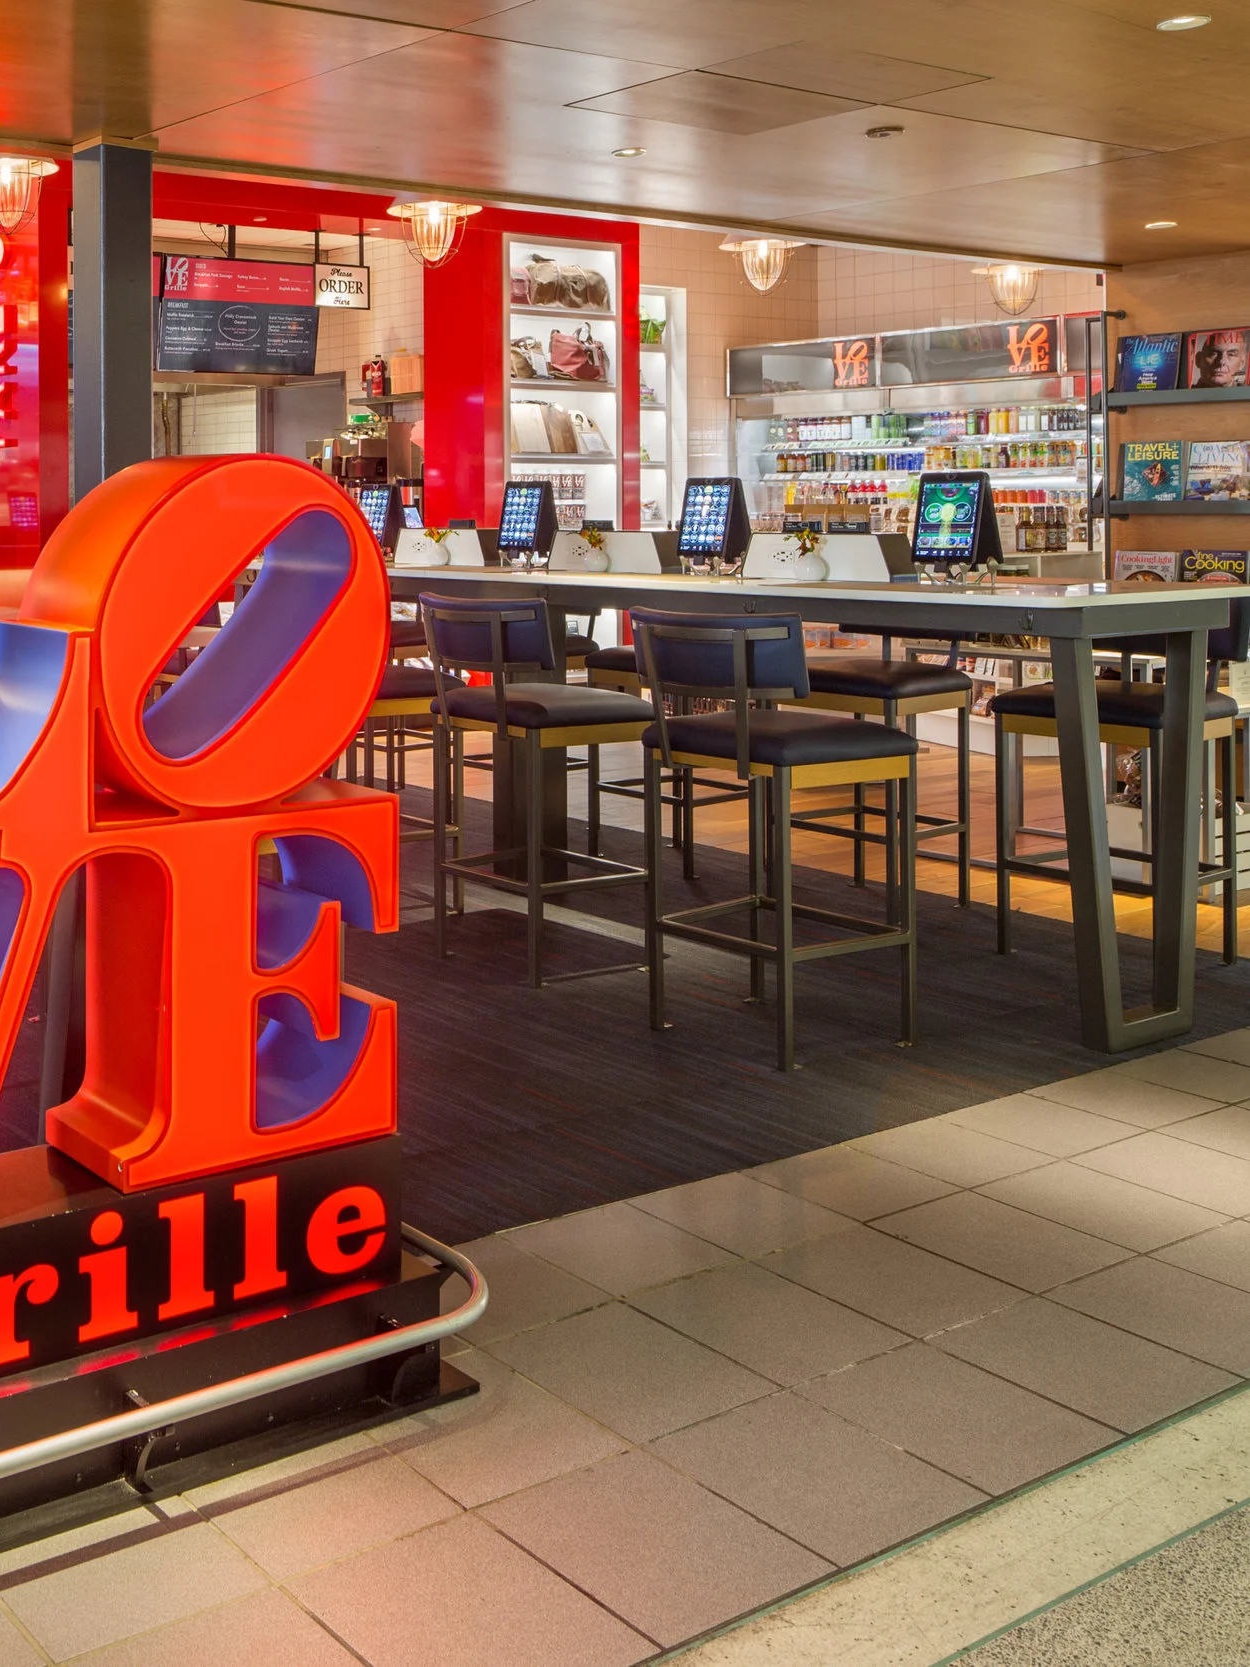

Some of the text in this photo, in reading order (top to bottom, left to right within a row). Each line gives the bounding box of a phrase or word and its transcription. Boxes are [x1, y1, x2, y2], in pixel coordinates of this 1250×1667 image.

[330, 267, 352, 277] Please
[318, 278, 364, 295] ORDER
[333, 296, 351, 306] Here
[1206, 332, 1244, 346] TIME
[1129, 336, 1179, 355] Atlantic
[1008, 362, 1048, 373] Grille
[834, 378, 868, 387] Grille
[1127, 450, 1180, 461] LEISURE
[1197, 551, 1214, 560] fine
[1185, 556, 1245, 574] Cooking
